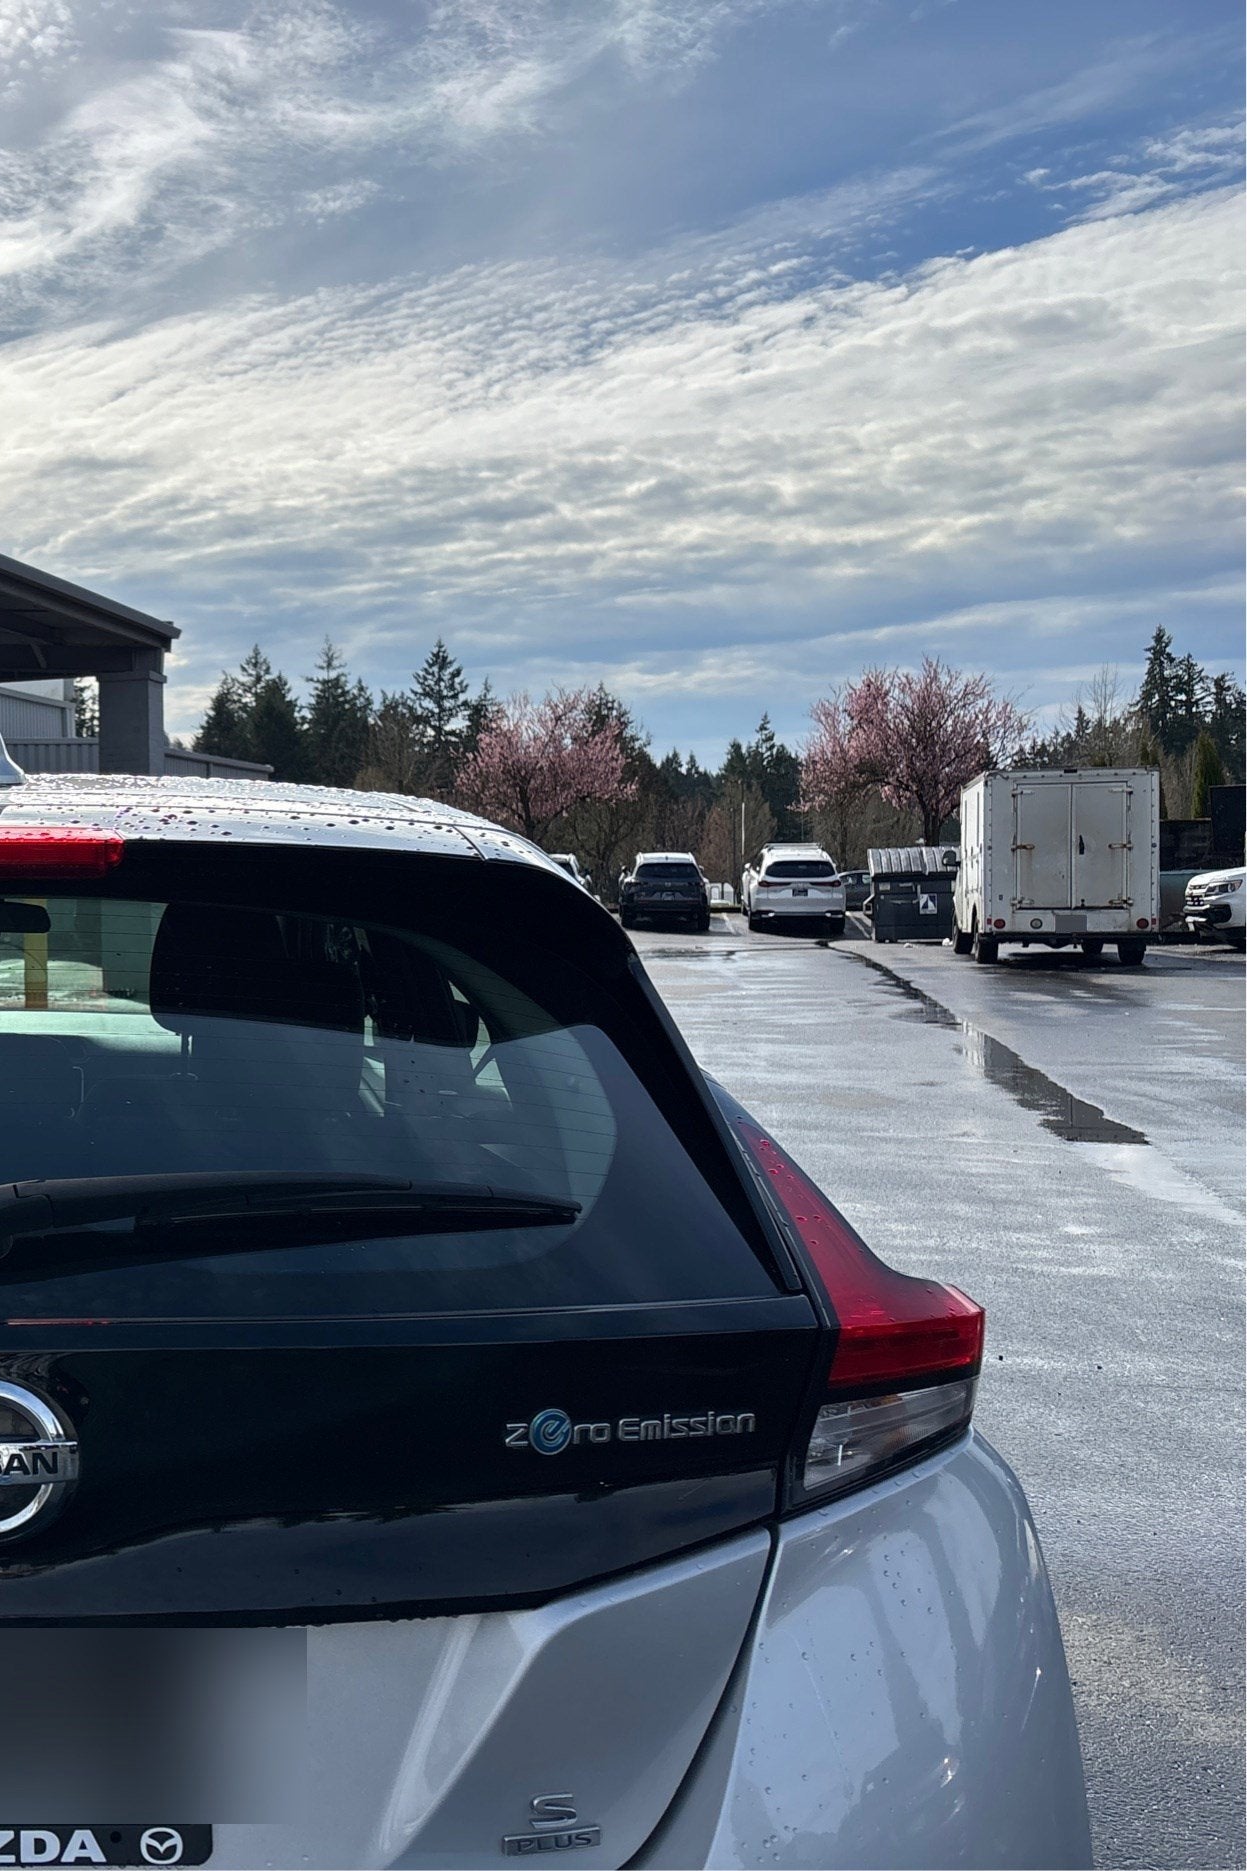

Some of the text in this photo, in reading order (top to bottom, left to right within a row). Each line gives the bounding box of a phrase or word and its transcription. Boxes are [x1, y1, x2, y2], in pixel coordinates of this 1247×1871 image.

[618, 1411, 756, 1442] Emission
[530, 1792, 577, 1829] S
[516, 1832, 593, 1853] PLUS
